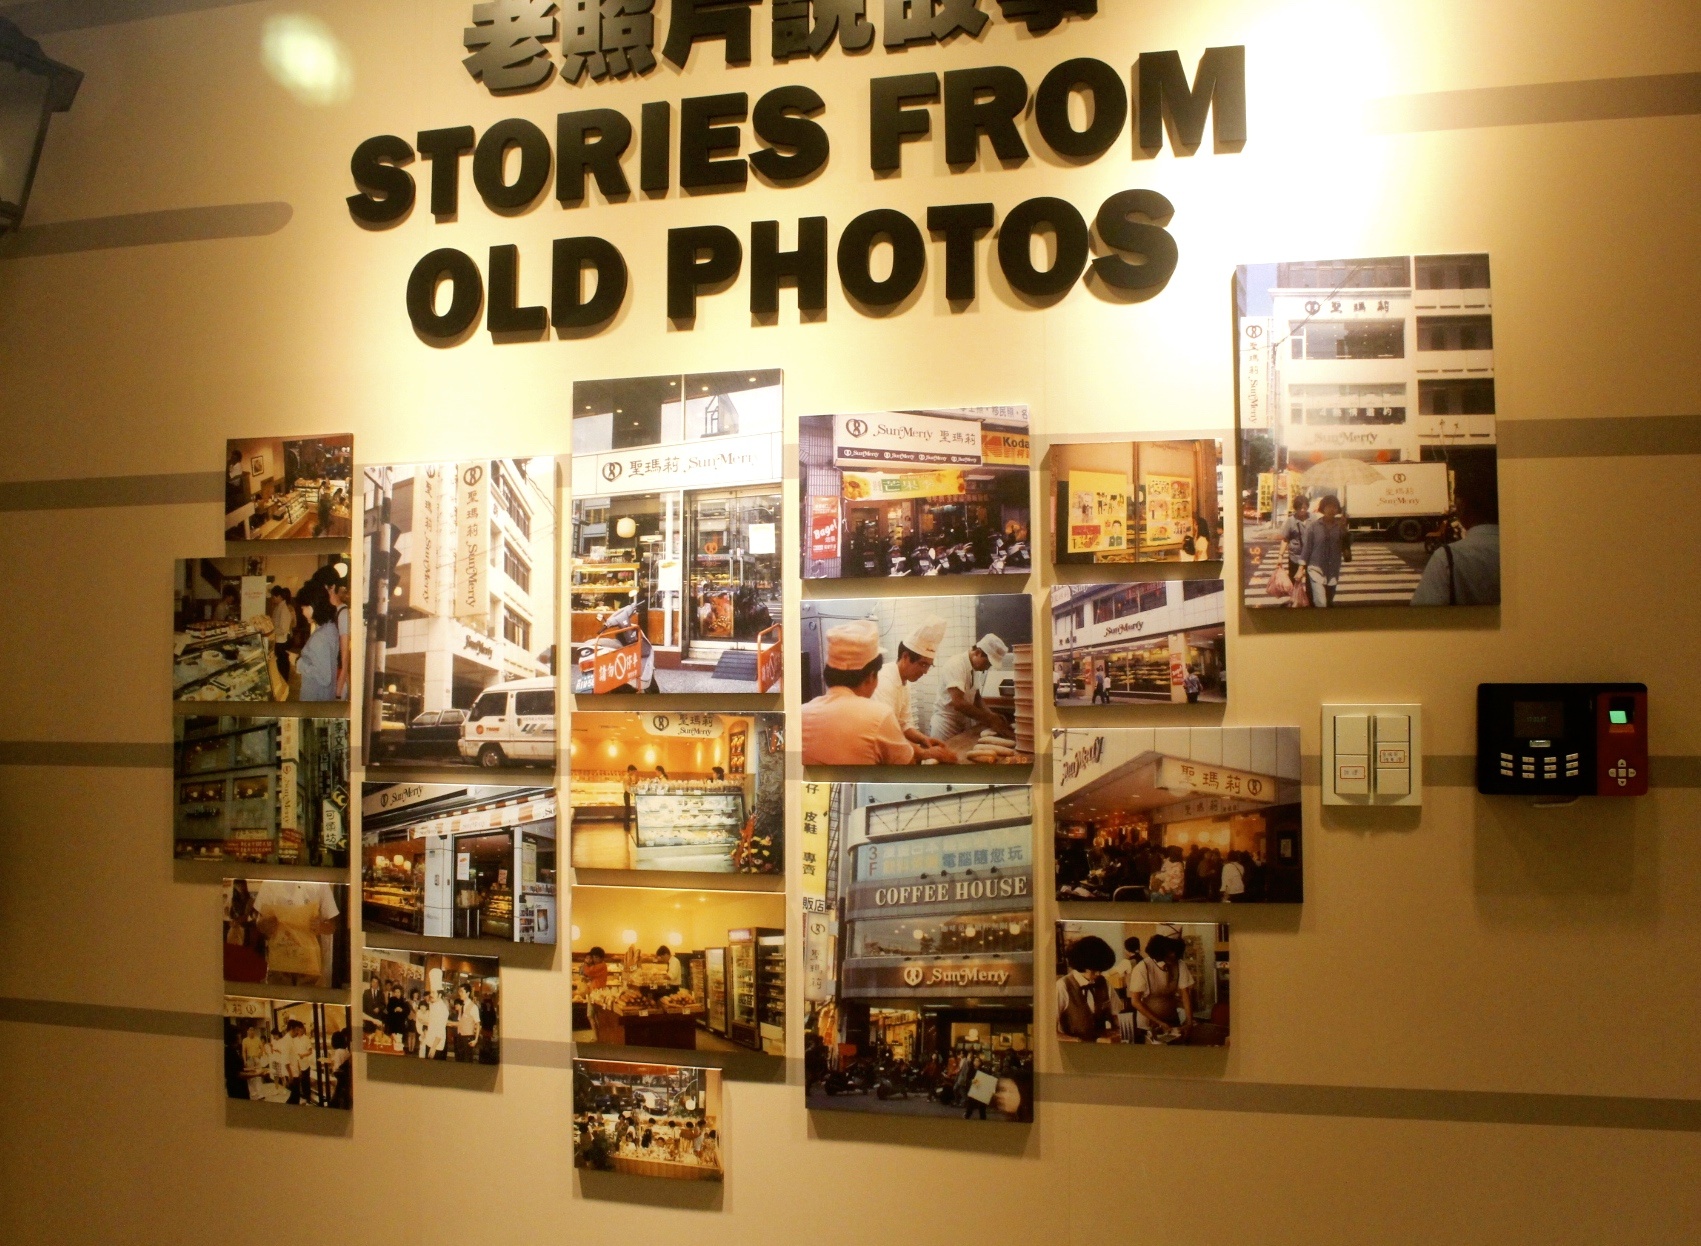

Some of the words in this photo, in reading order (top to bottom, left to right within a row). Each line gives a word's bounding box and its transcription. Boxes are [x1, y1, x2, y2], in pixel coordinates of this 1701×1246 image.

[346, 85, 830, 229] STORIES
[870, 45, 1247, 177] FROM
[406, 236, 628, 345] OLD
[667, 189, 1179, 329] PHOTOS
[873, 424, 933, 441] SunMerry
[940, 430, 976, 446] 聖瑪莉
[628, 456, 680, 478] 聖瑪莉
[466, 490, 479, 538] 聖瑪莉
[813, 518, 838, 540] Bagel
[465, 541, 479, 608] SunMerry
[678, 714, 714, 727] 聖瑪莉
[678, 727, 712, 736] SunMerry
[1180, 764, 1242, 794] 聖瑪莉
[942, 845, 1023, 868] 電腦隨您玩
[875, 883, 949, 906] COFFEE
[955, 876, 1027, 900] HOUSE
[926, 966, 1010, 986] SunMerry
